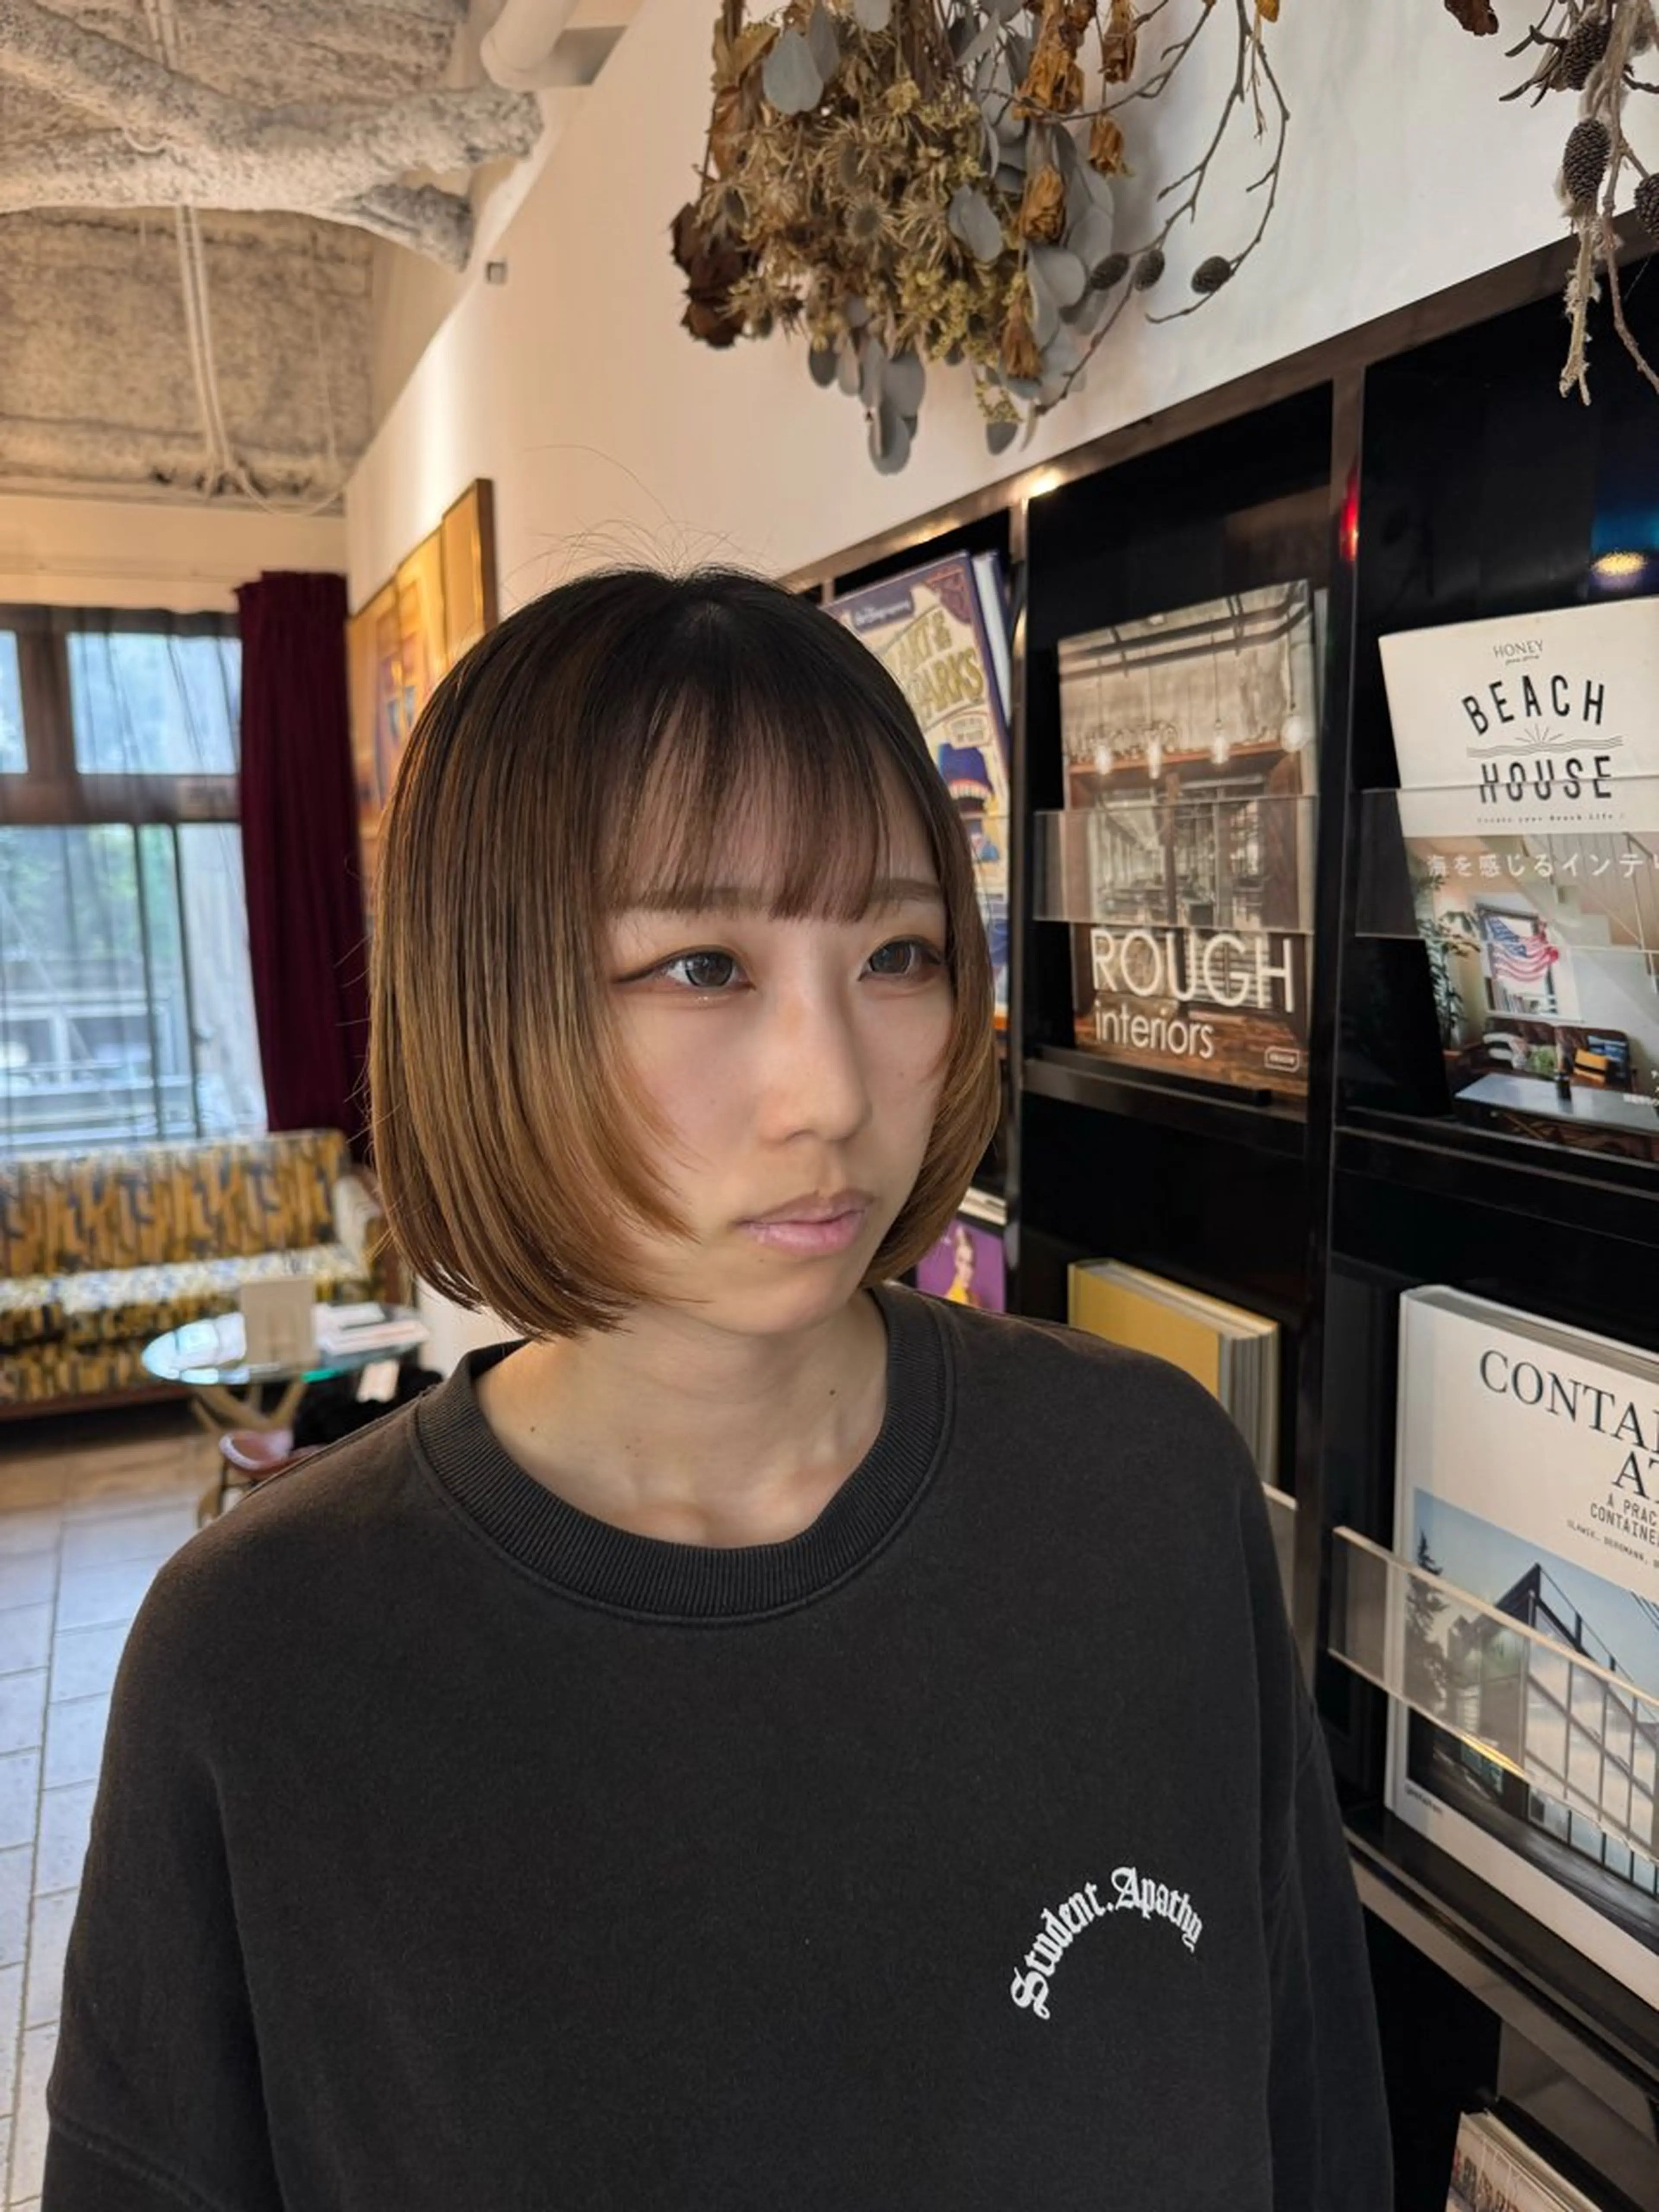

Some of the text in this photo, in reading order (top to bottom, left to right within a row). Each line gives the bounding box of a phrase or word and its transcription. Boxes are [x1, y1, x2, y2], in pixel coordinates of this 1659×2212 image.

[1493, 639, 1543, 658] HONEY
[1462, 674, 1605, 735] BEACH
[1480, 756, 1611, 804] HOUSE
[1090, 928, 1294, 1013] ROUGH
[1094, 999, 1214, 1059] interiors
[1590, 1502, 1659, 1548] CONTAINE
[1624, 1499, 1658, 1526] PRAC
[1011, 1867, 1203, 2020] Student Apathy
